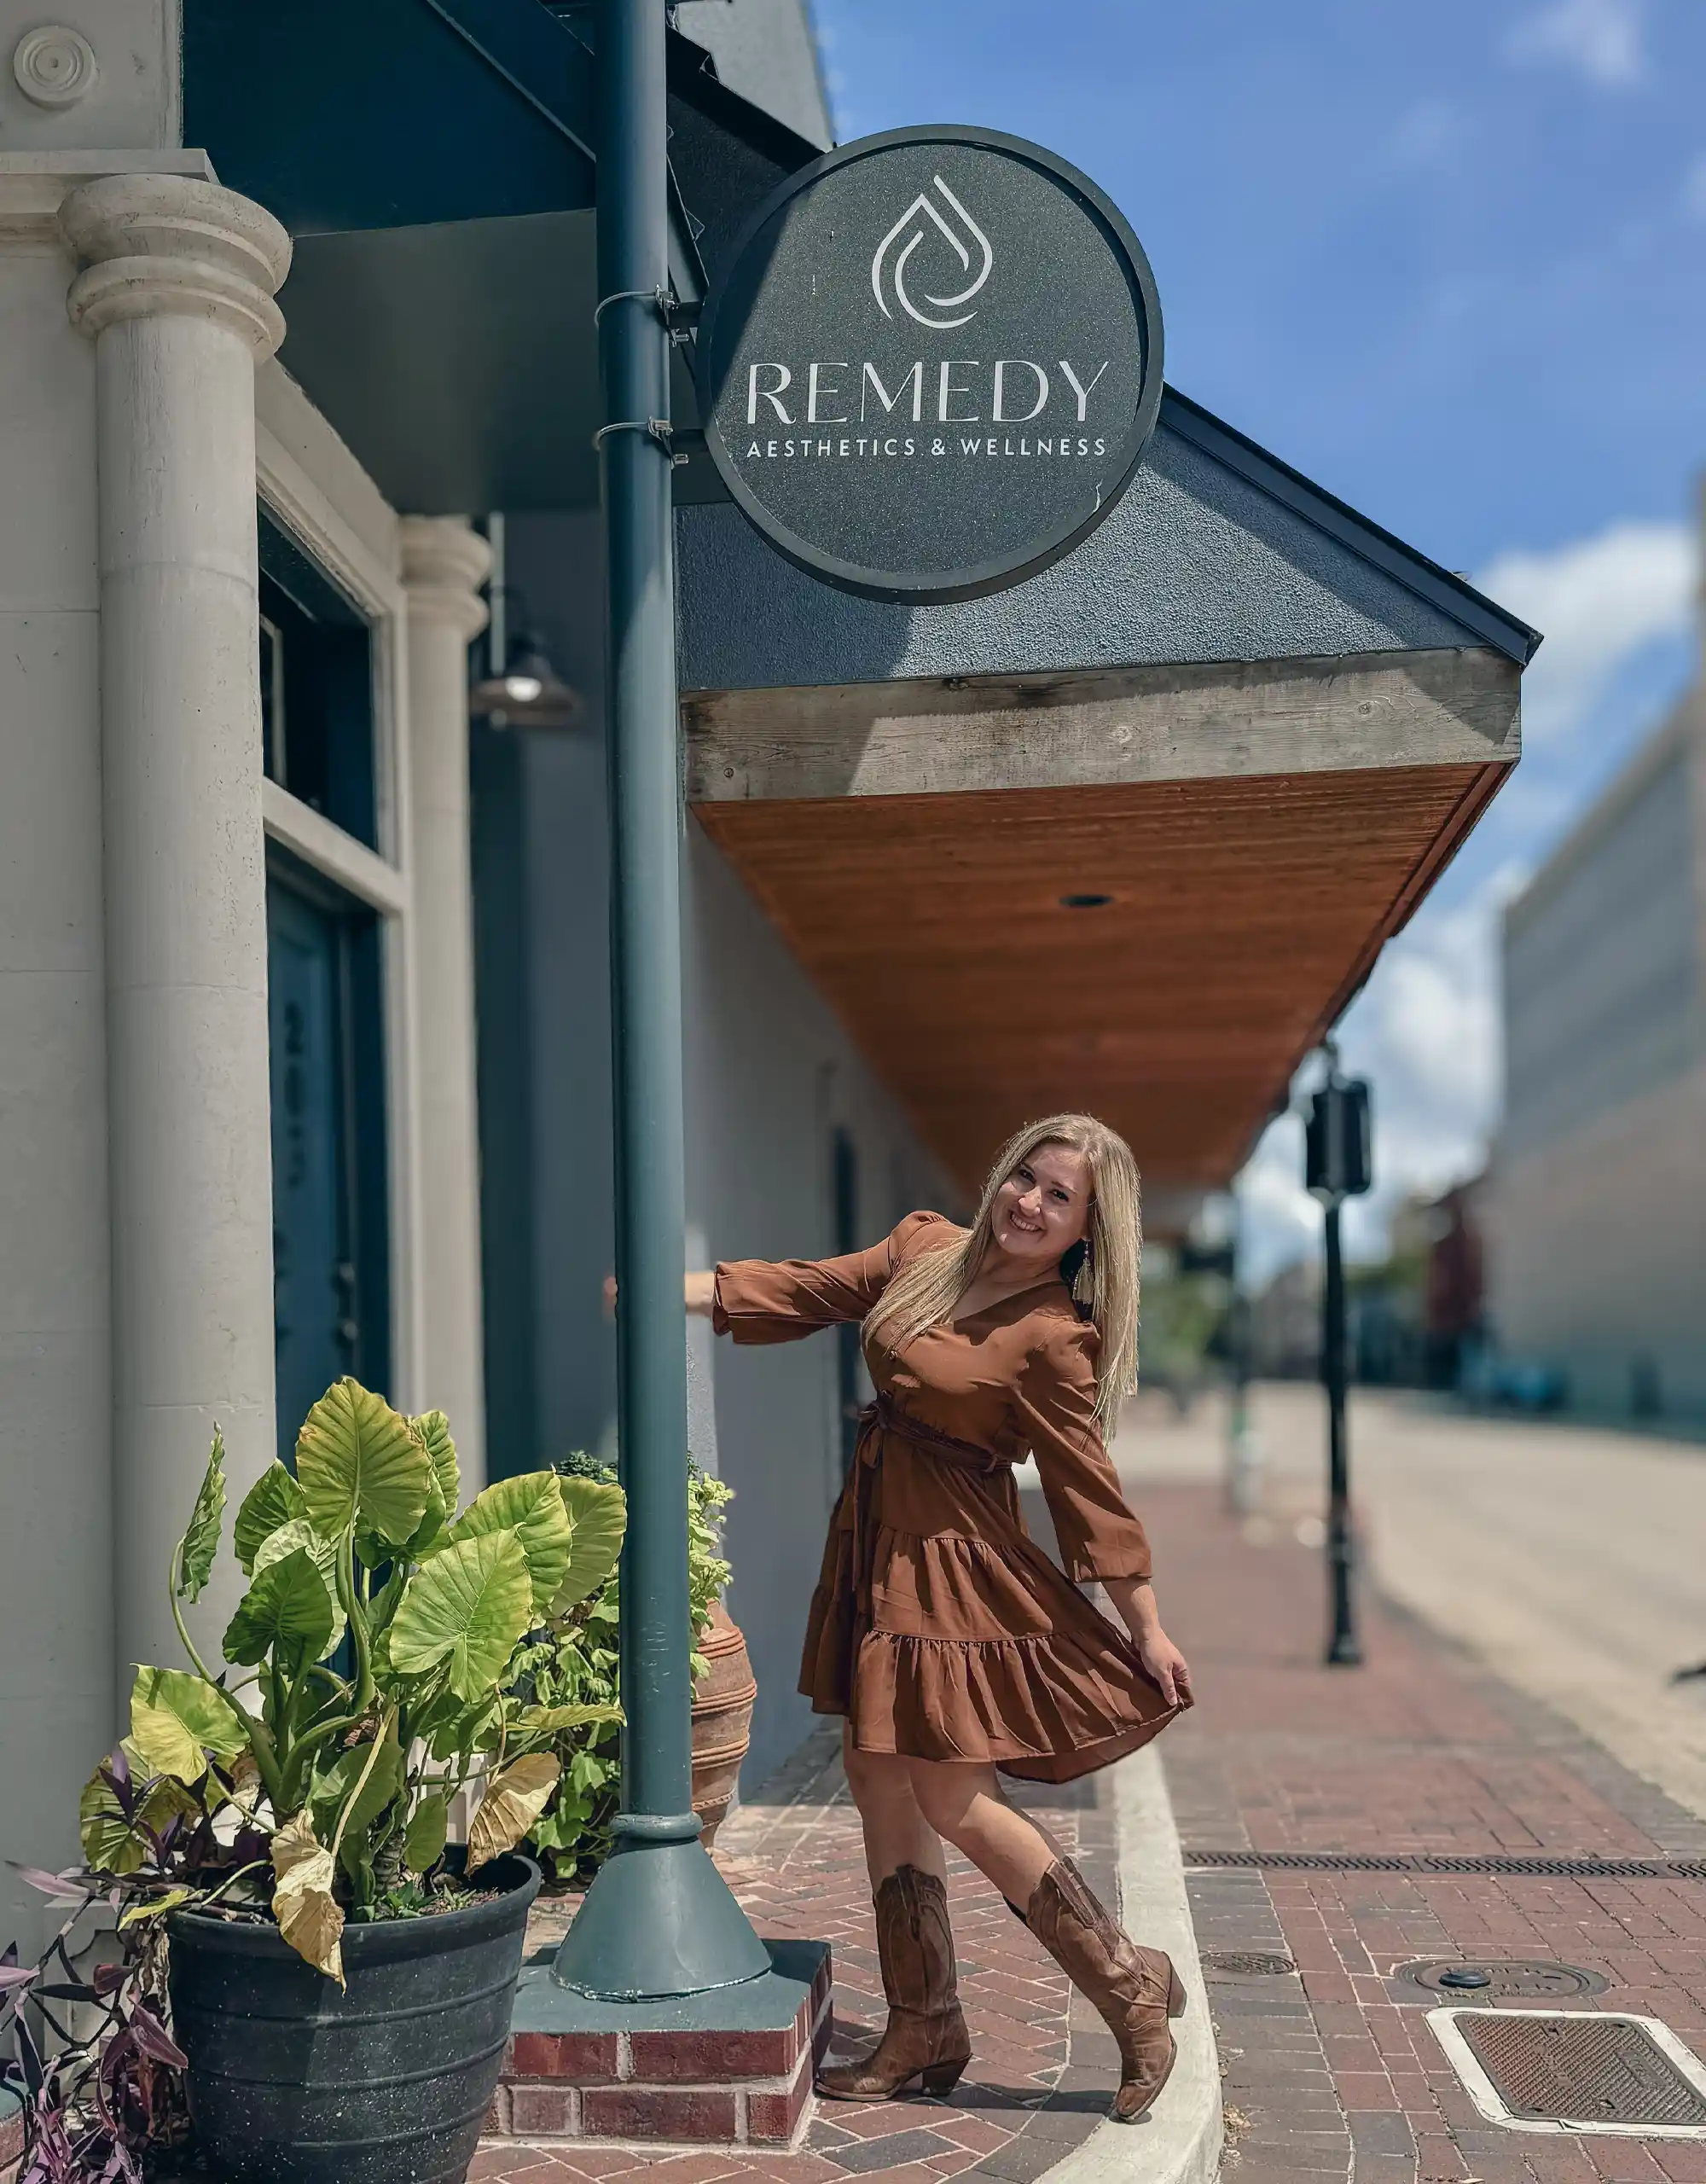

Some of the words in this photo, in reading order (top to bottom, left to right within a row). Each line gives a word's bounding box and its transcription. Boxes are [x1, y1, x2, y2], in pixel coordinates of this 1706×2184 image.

[746, 359, 1110, 425] REMEDY
[746, 438, 915, 458] AESTHETICS
[931, 437, 946, 456] &
[960, 437, 1105, 457] WELLNESS
